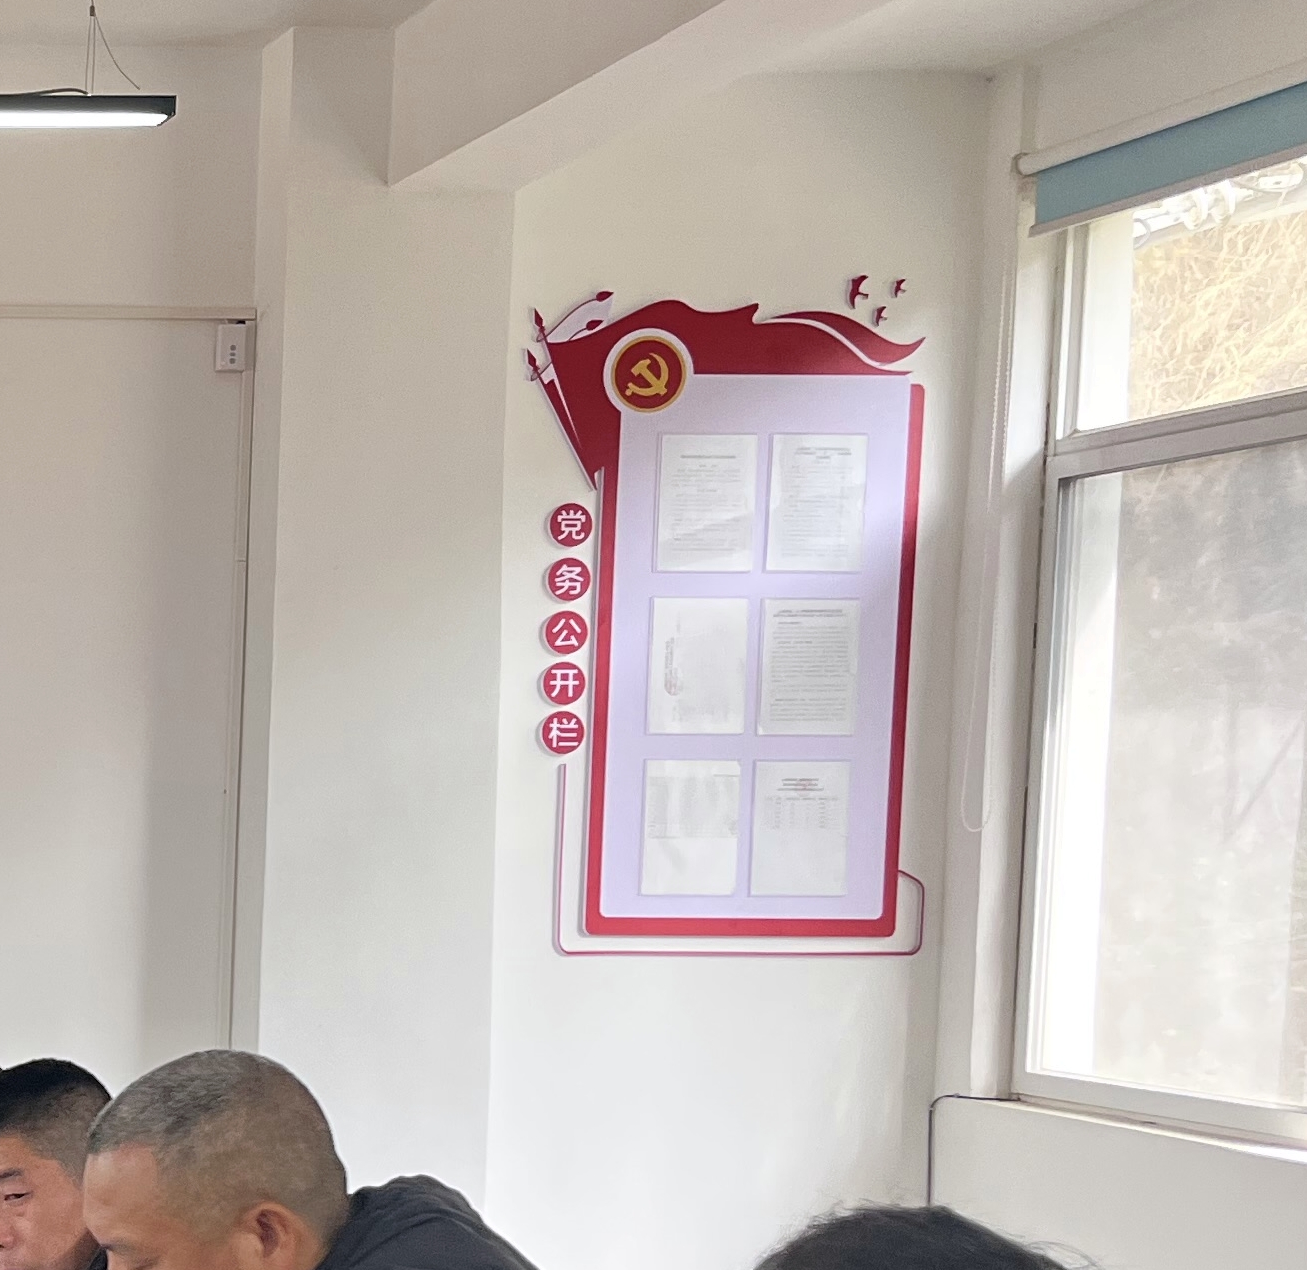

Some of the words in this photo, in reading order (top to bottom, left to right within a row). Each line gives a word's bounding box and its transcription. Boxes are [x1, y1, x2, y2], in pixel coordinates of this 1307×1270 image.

[547, 509, 587, 749] 党务公开栏
